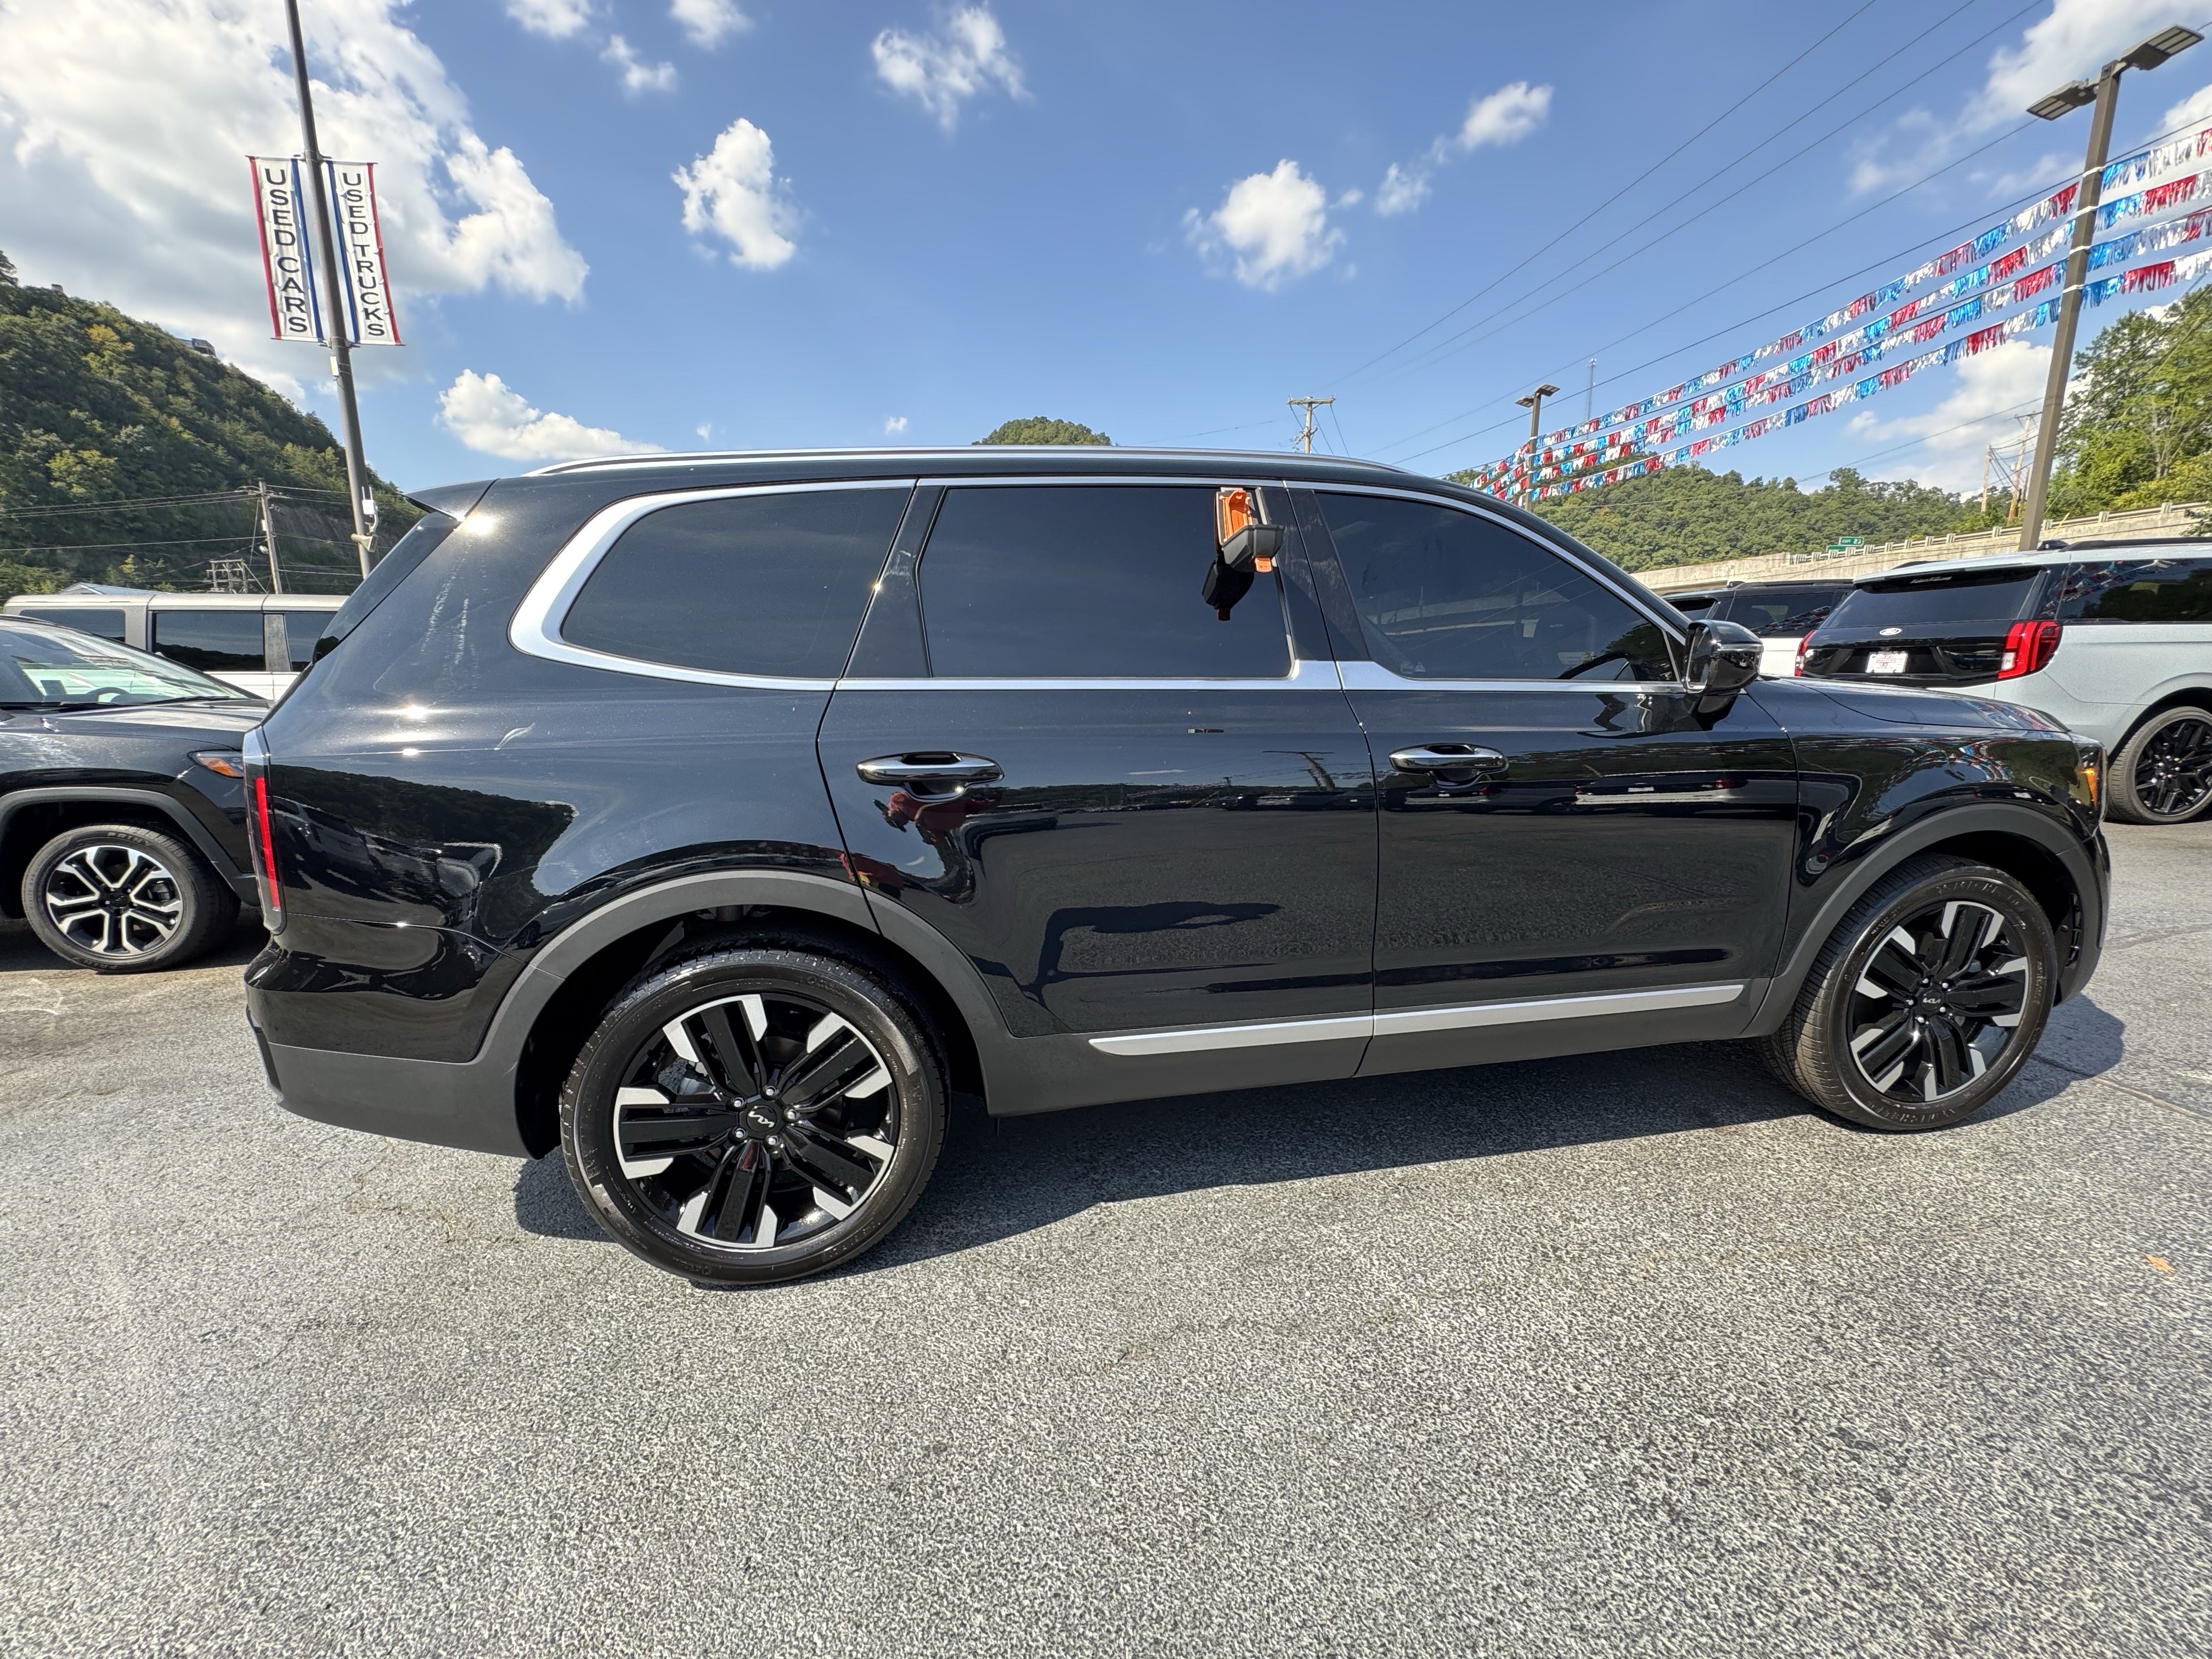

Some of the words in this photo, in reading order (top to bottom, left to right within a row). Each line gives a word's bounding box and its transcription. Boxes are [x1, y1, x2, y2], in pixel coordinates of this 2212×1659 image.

[265, 168, 296, 246] USED
[342, 172, 368, 235] USED
[278, 257, 308, 332] CARS
[353, 244, 385, 336] TRUCKS
[748, 1111, 775, 1128] KIA
